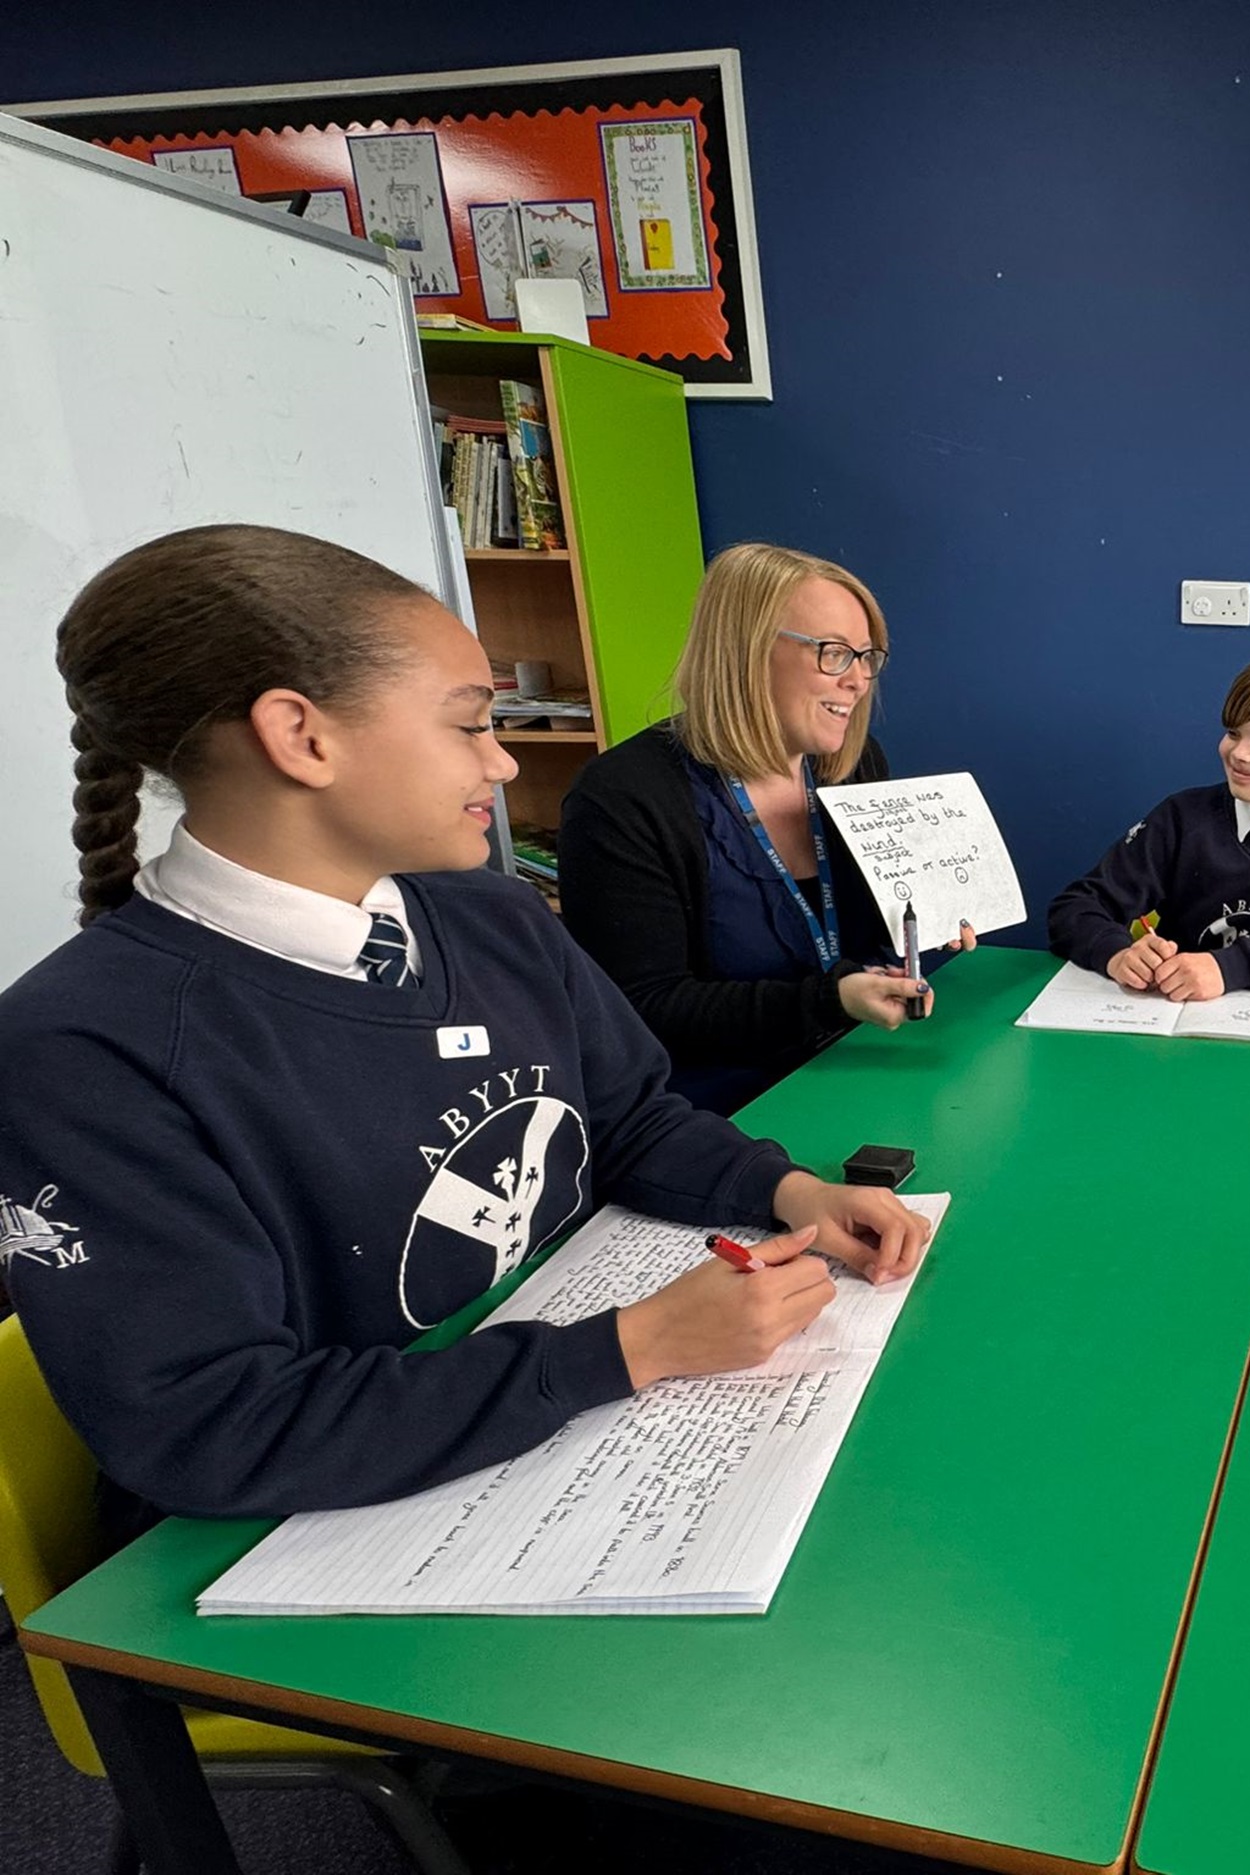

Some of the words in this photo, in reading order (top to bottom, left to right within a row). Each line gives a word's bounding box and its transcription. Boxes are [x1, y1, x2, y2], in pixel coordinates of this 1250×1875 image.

[834, 801, 866, 814] The
[850, 813, 915, 833] destroyed
[919, 809, 939, 825] by
[942, 807, 966, 818] the
[767, 848, 787, 873] STAFF
[923, 861, 933, 871] or
[795, 892, 814, 917] STAFF
[822, 882, 834, 909] STAFF
[815, 937, 830, 961] STAFF
[828, 930, 839, 956] STAFF
[457, 1033, 472, 1052] J
[419, 1065, 551, 1170] ABYYT
